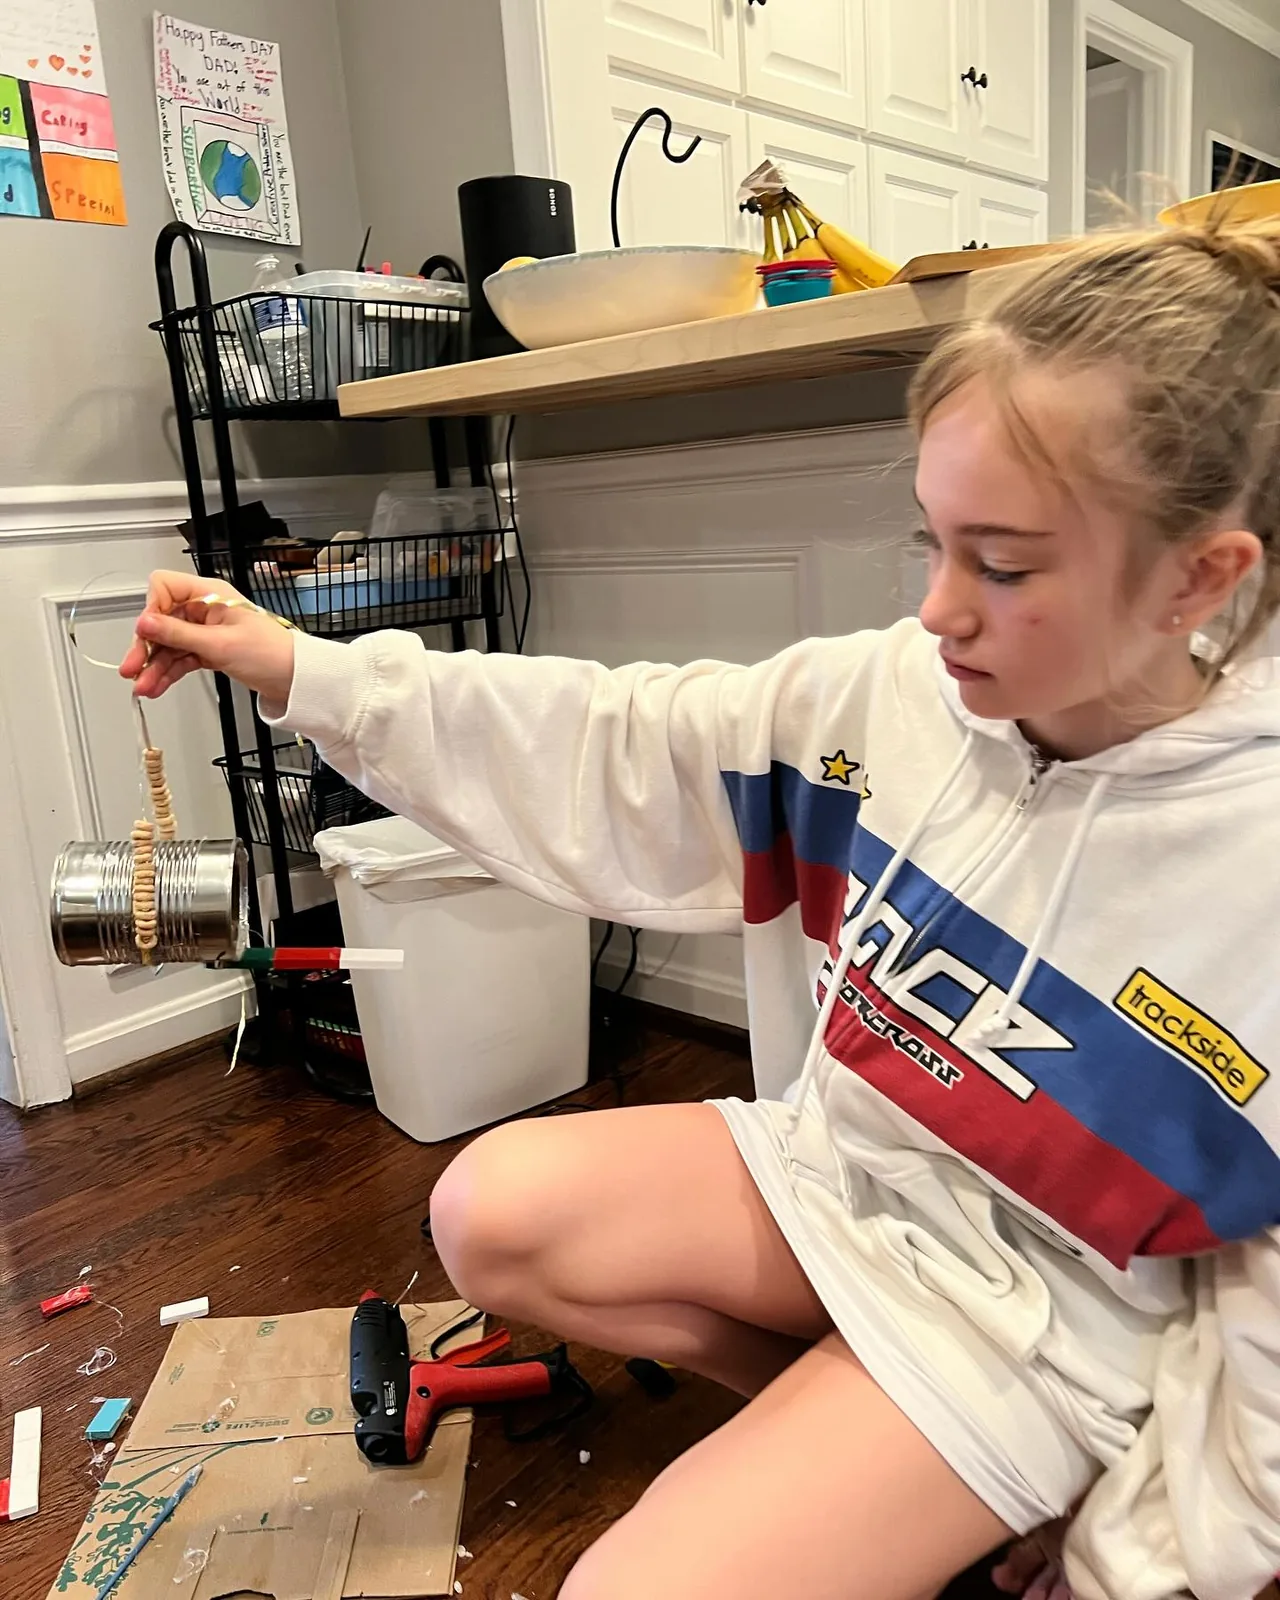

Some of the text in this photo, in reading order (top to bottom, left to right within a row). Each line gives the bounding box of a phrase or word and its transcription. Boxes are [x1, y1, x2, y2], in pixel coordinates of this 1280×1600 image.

[165, 17, 205, 52] Happy
[250, 40, 274, 56] DAY
[203, 54, 238, 75] DAD!
[548, 188, 557, 216] SONOS
[1129, 985, 1245, 1088] trackside
